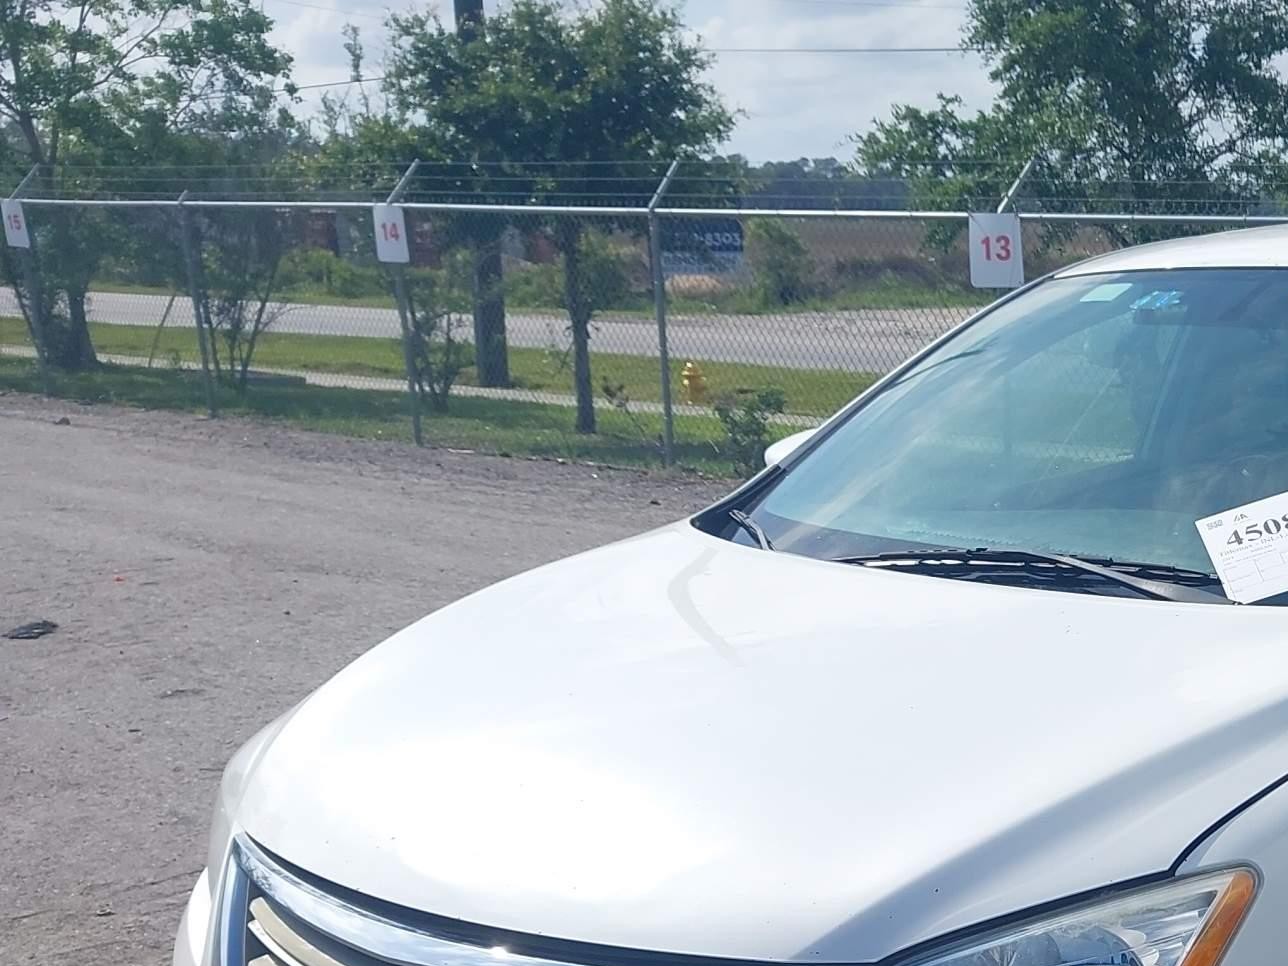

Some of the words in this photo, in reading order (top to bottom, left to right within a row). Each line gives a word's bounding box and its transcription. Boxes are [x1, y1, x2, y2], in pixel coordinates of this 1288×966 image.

[8, 214, 21, 230] 15
[381, 222, 399, 240] 14
[981, 235, 1011, 261] 13
